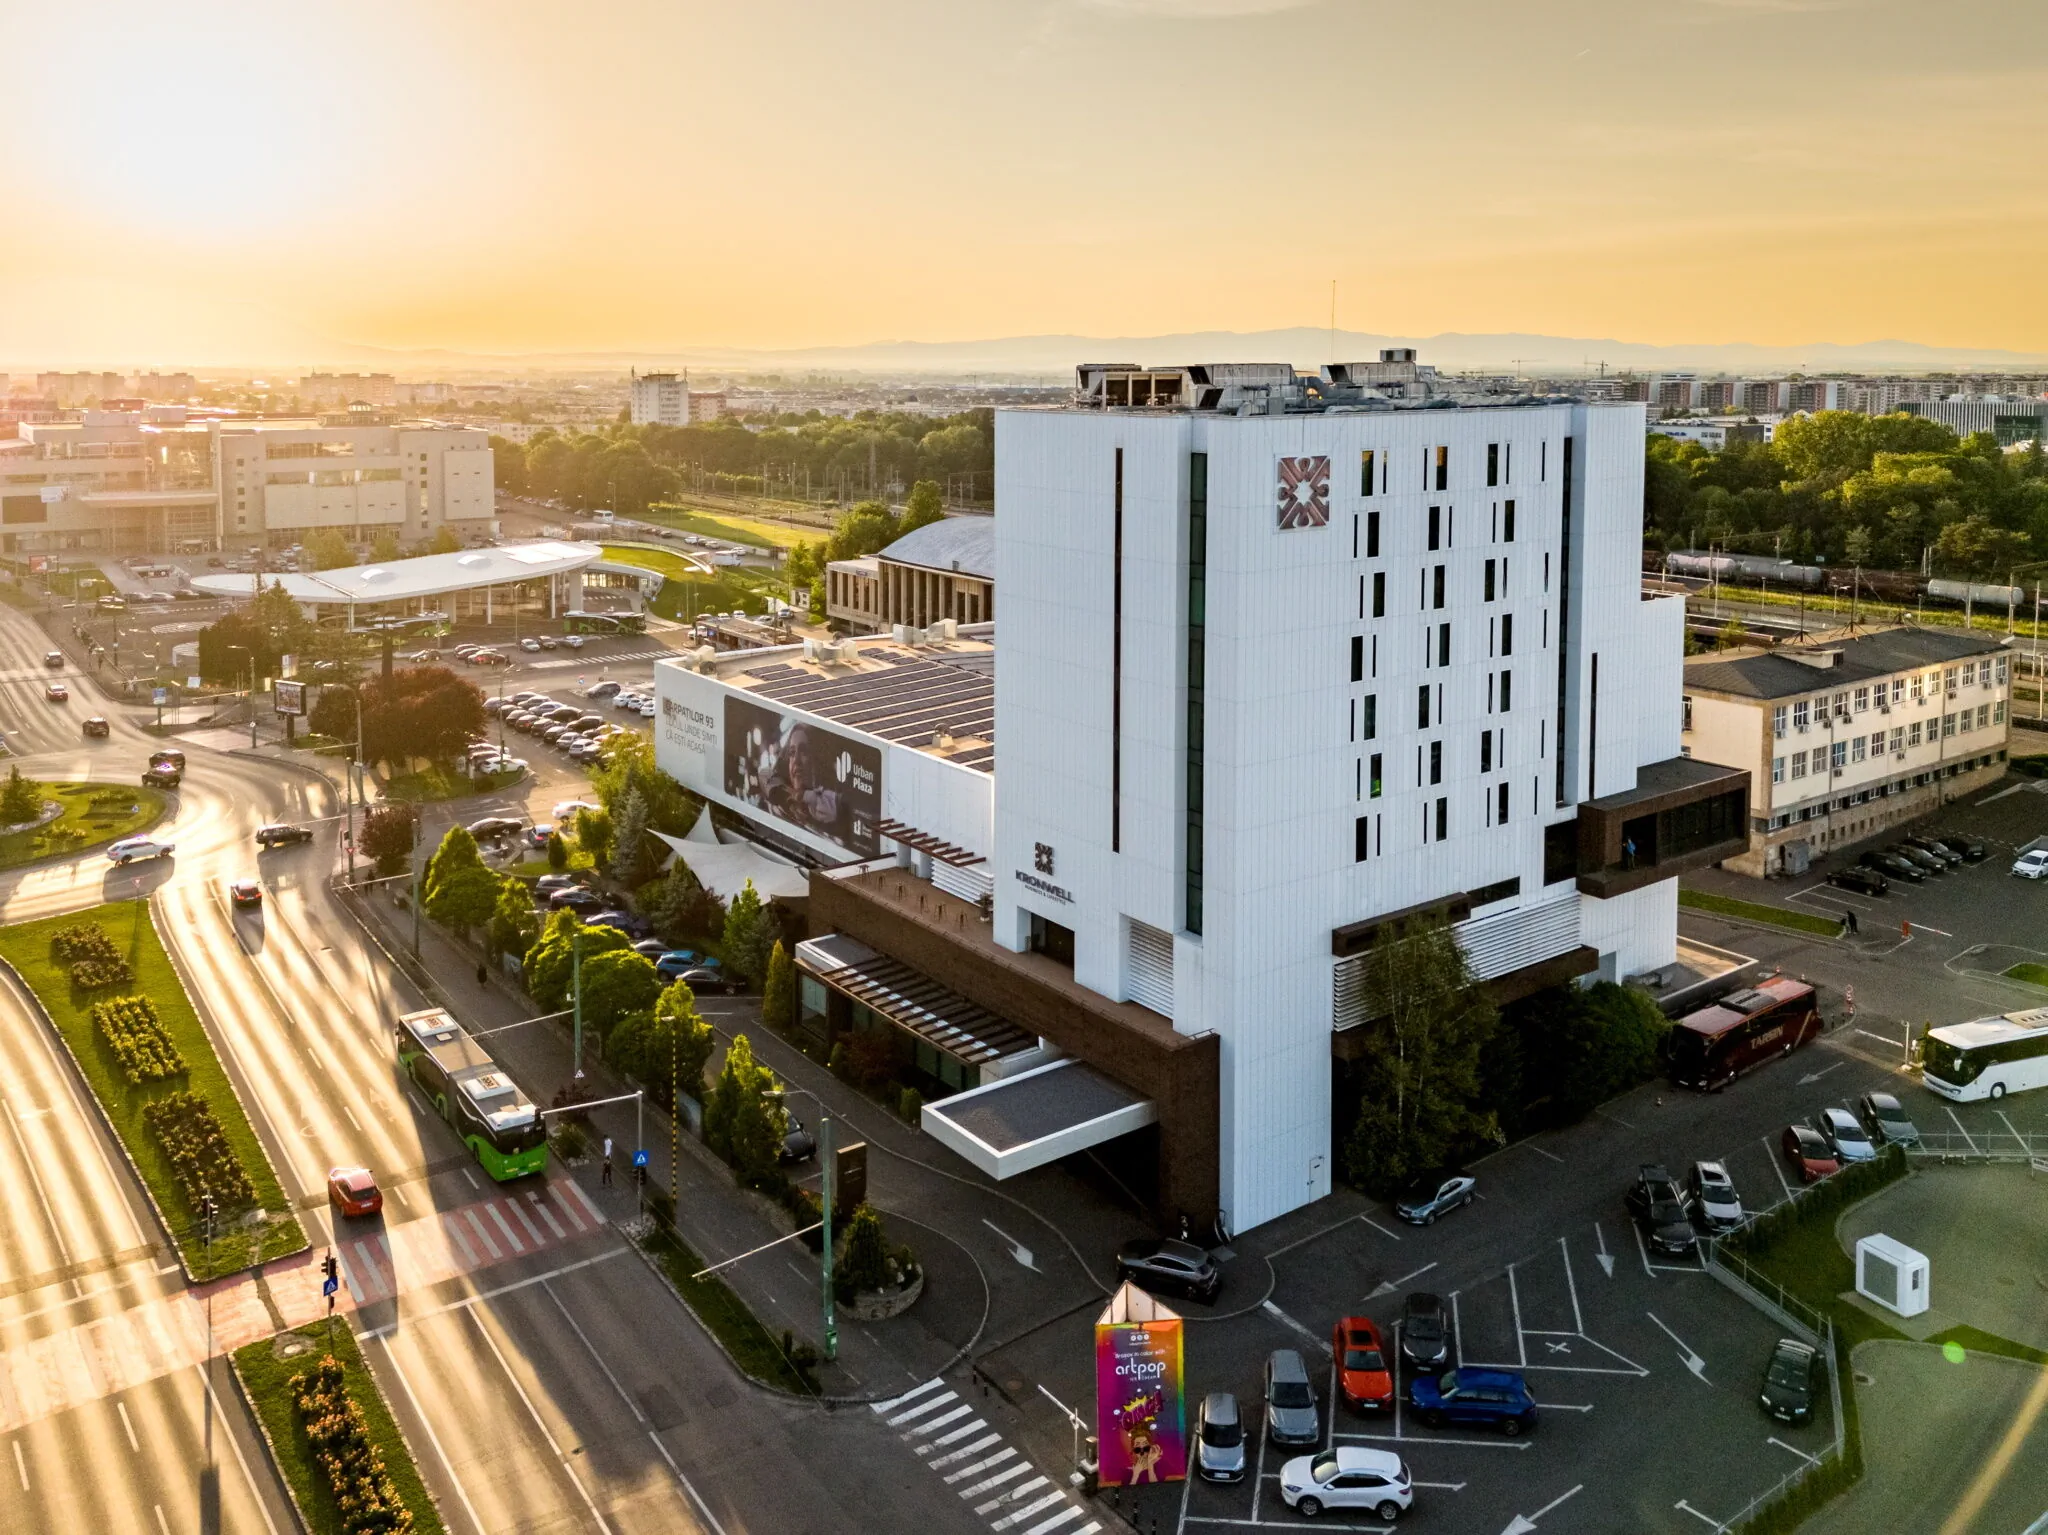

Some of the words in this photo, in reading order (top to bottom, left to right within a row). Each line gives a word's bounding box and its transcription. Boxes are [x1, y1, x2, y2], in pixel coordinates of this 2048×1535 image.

[705, 715, 714, 728] 93
[853, 763, 873, 782] Urban
[853, 776, 873, 795] Plaza
[1015, 869, 1076, 903] KRONWELL
[1115, 1357, 1166, 1380] artpop
